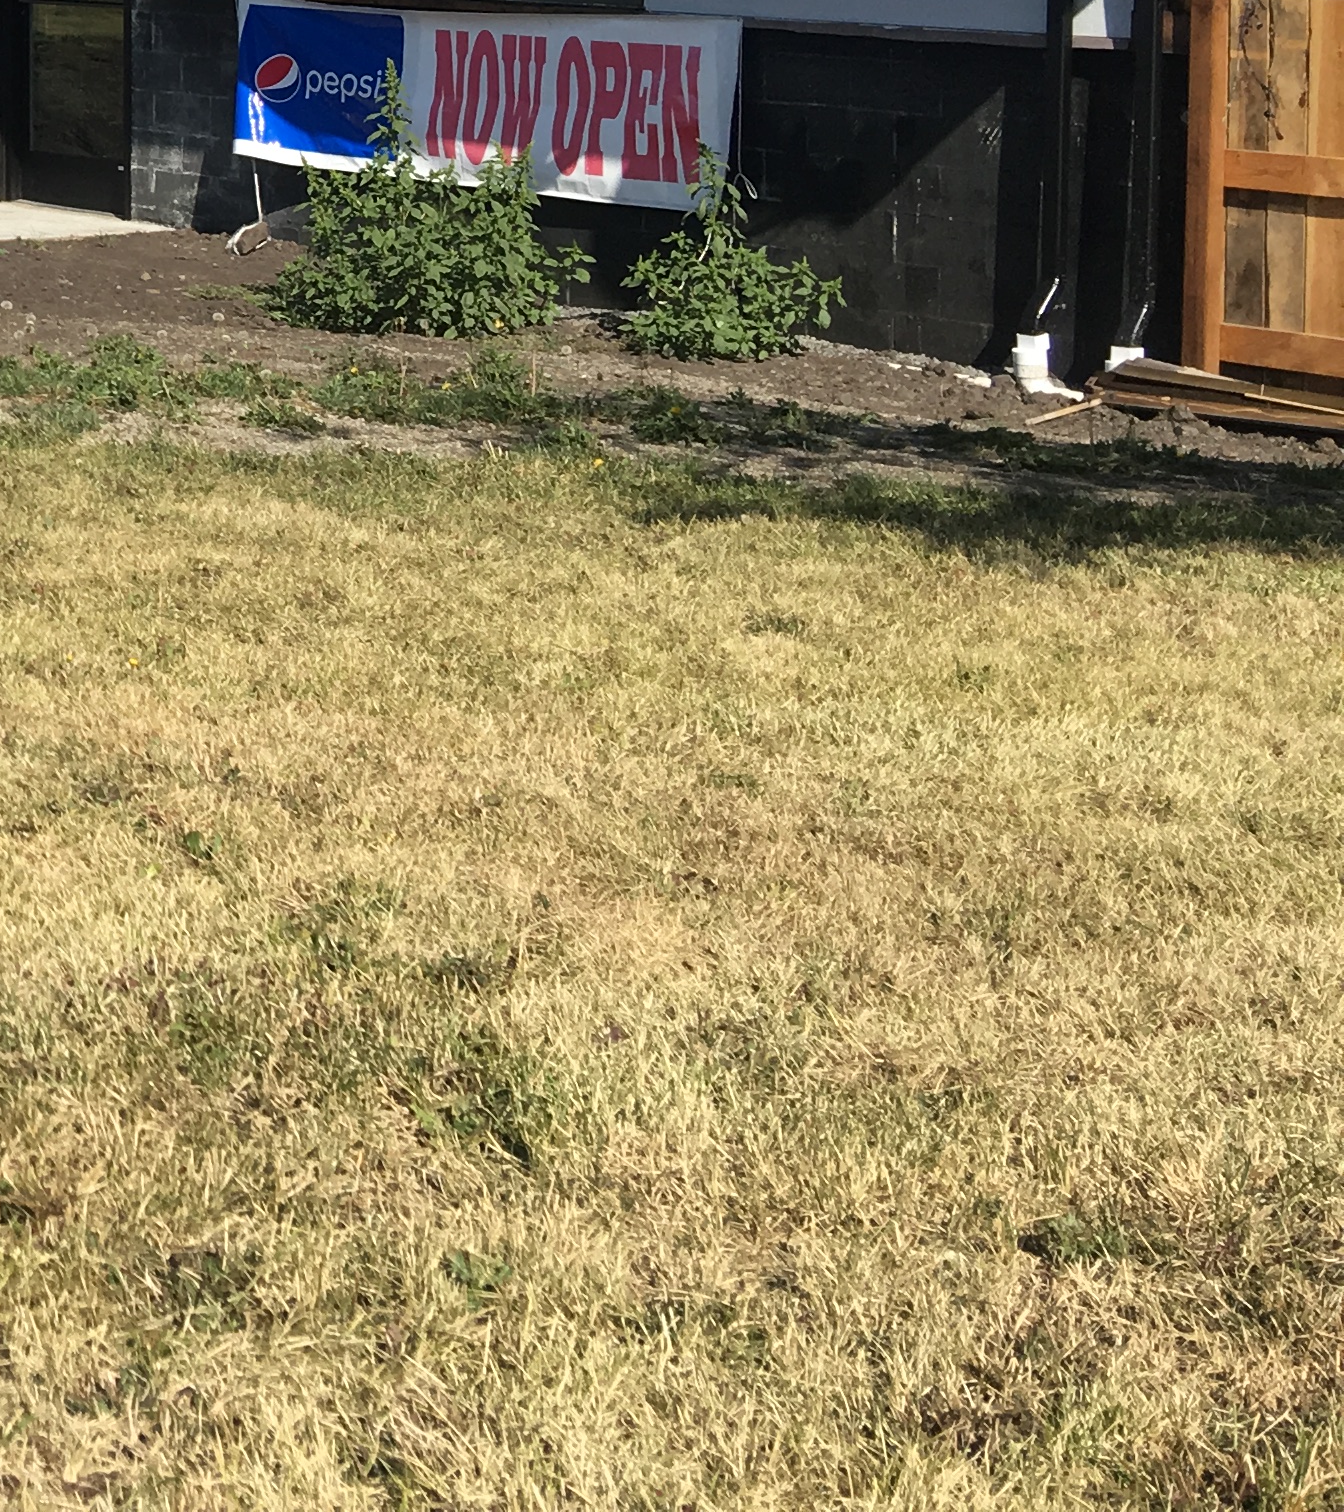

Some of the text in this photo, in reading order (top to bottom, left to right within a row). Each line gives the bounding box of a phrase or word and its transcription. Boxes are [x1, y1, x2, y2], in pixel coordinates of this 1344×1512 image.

[304, 69, 383, 103] pepsi
[425, 29, 702, 184] NOW OPEN
